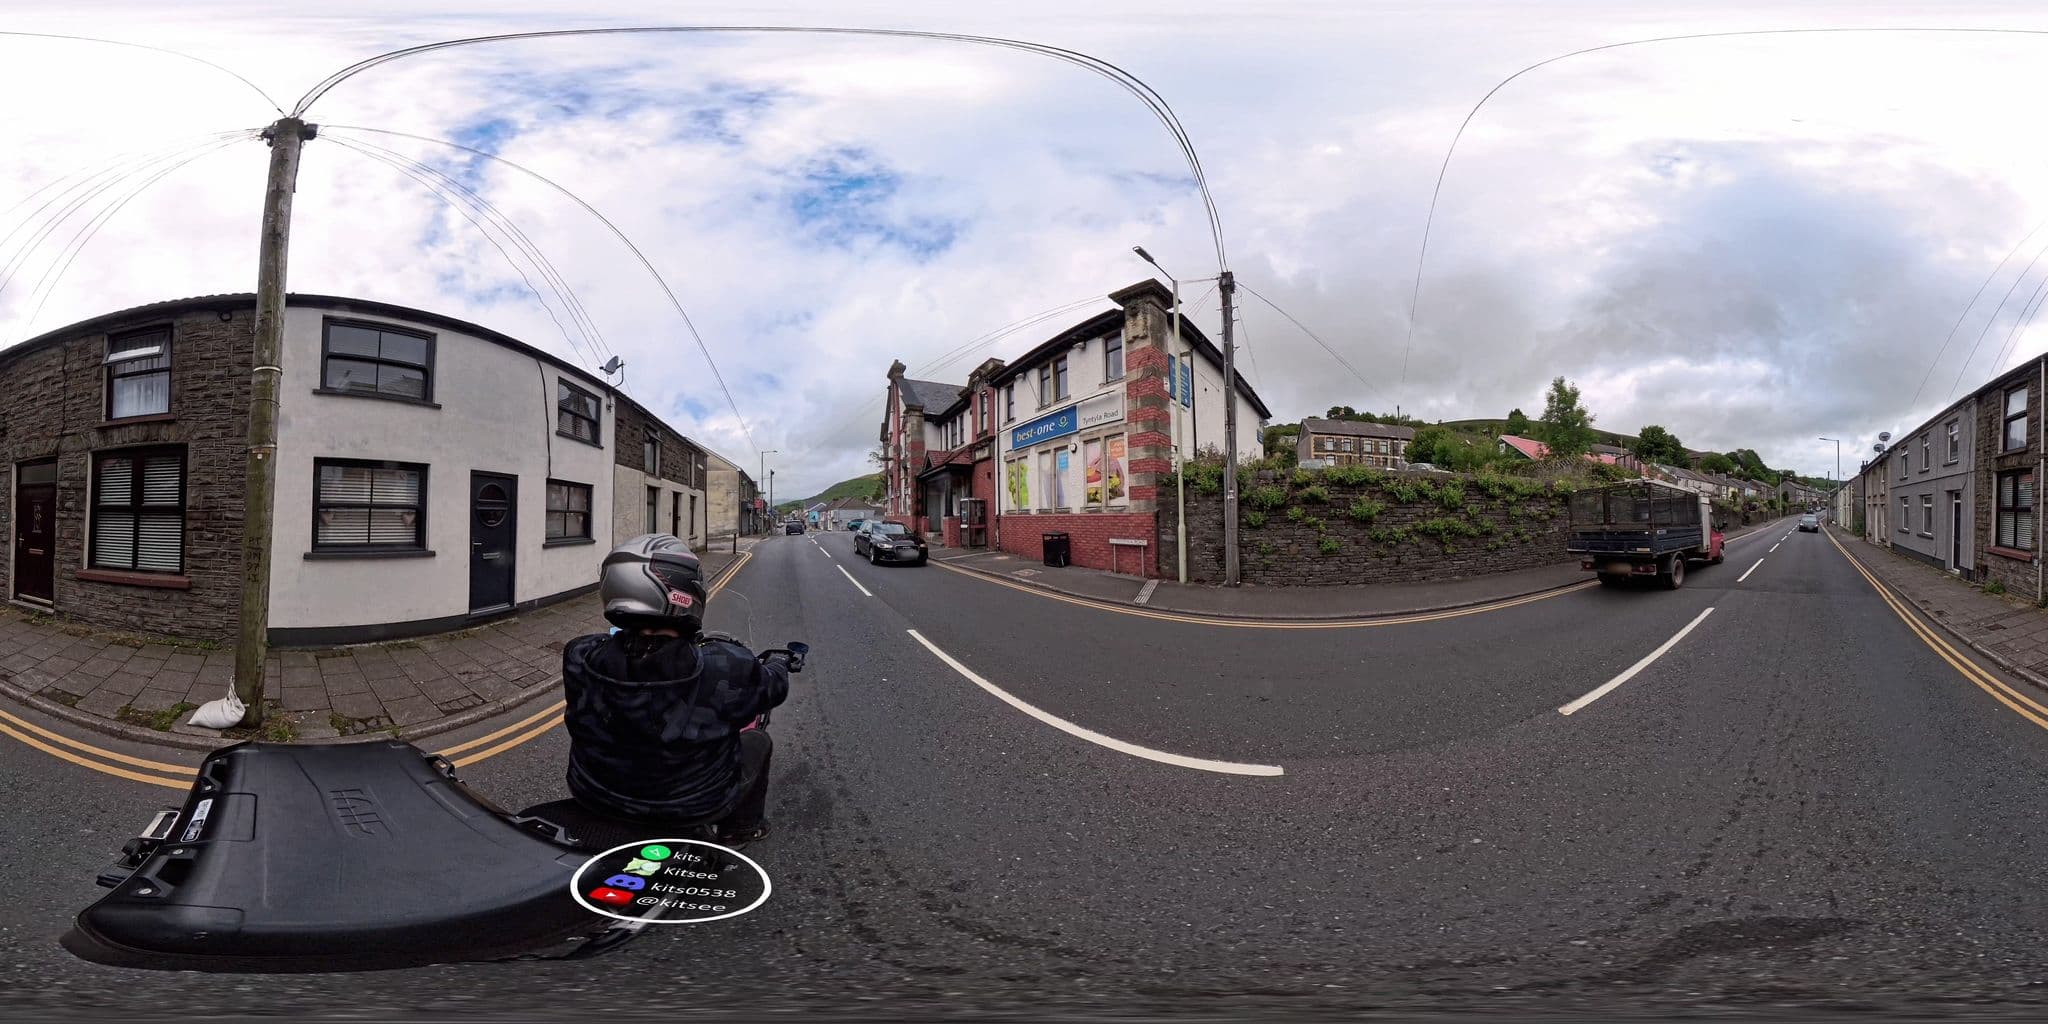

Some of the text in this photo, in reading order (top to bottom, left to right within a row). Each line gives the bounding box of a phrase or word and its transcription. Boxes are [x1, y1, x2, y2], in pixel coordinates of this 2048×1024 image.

[1104, 410, 1119, 419] Road
[1016, 421, 1056, 442] best-one
[672, 593, 690, 605] SHOEI
